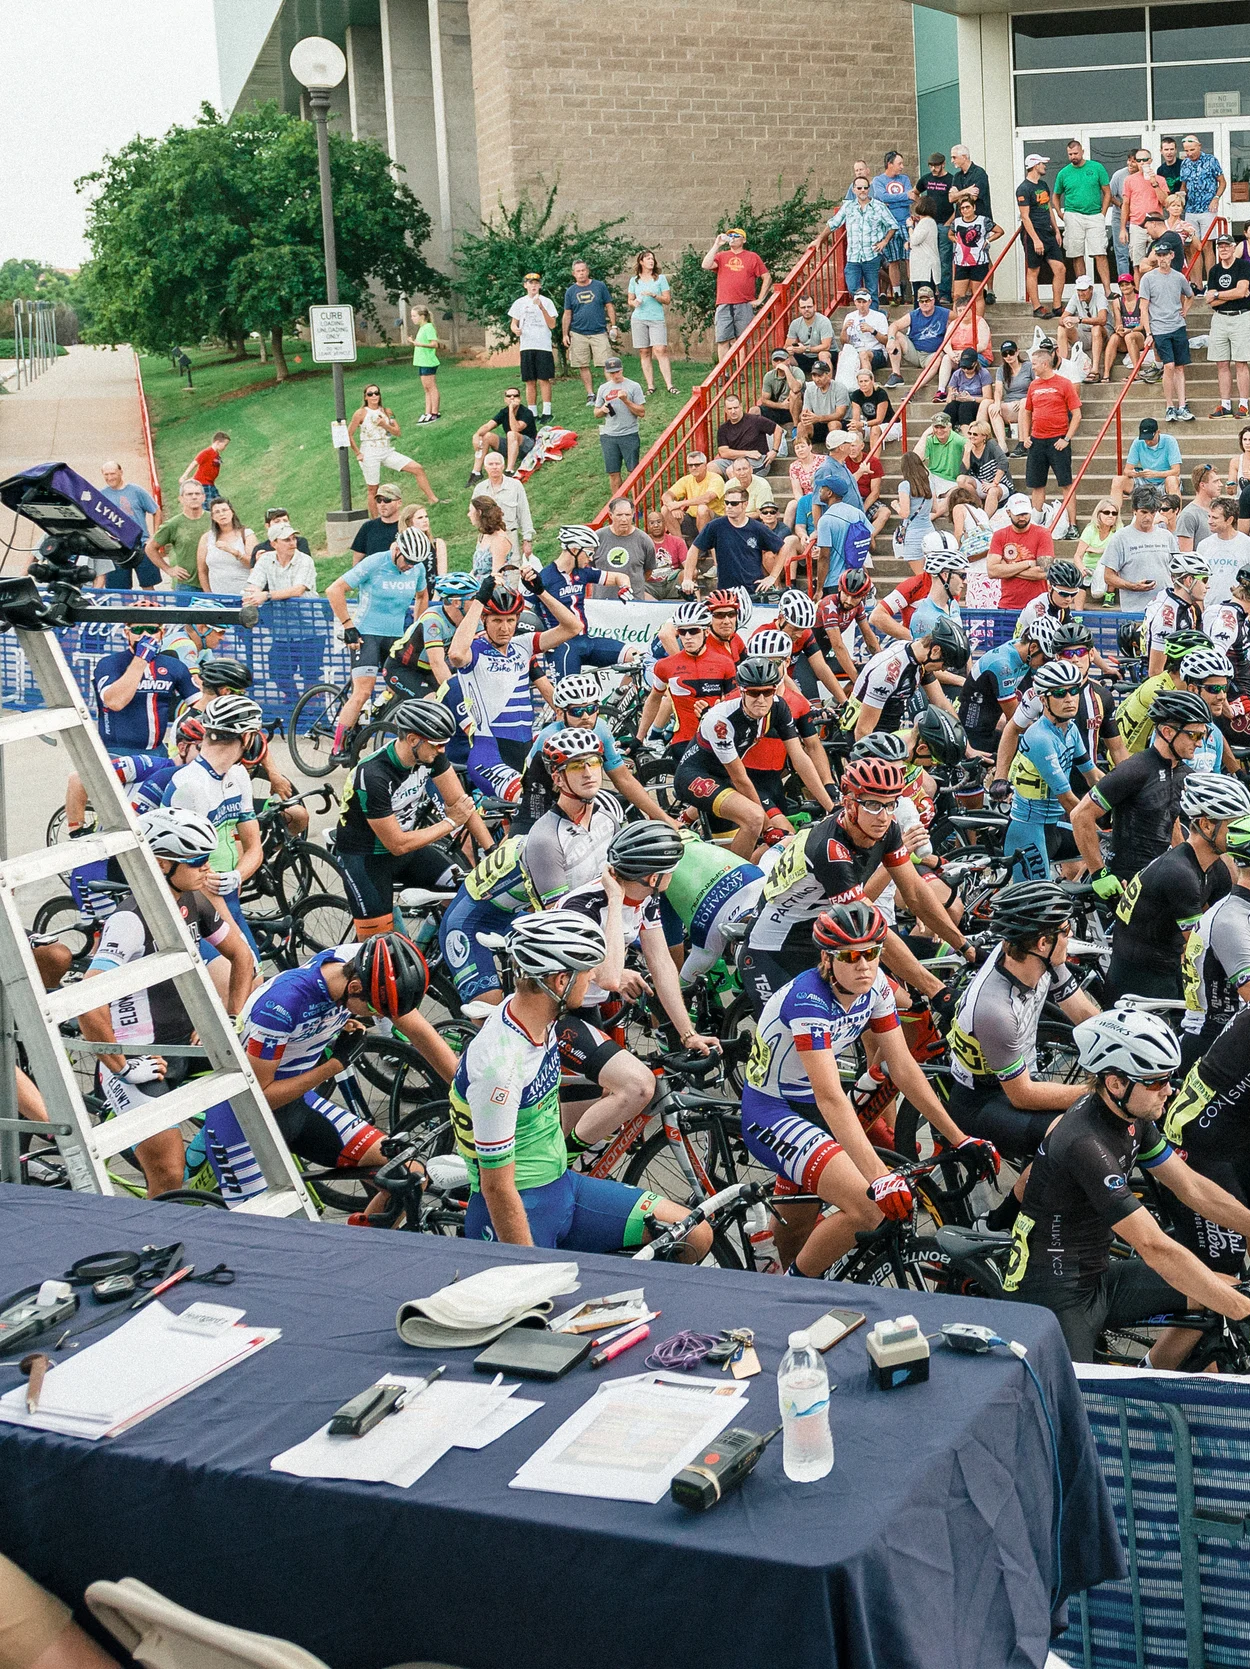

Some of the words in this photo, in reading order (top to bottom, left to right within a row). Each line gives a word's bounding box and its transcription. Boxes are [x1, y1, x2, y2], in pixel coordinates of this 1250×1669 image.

[320, 312, 342, 320] CURB
[94, 501, 125, 528] LYNX
[1024, 842, 1046, 880] TRP
[120, 992, 140, 1027] ELBOW
[350, 1130, 378, 1156] FRISCO
[748, 1122, 798, 1162] rbm
[1050, 1214, 1062, 1246] SMITH
